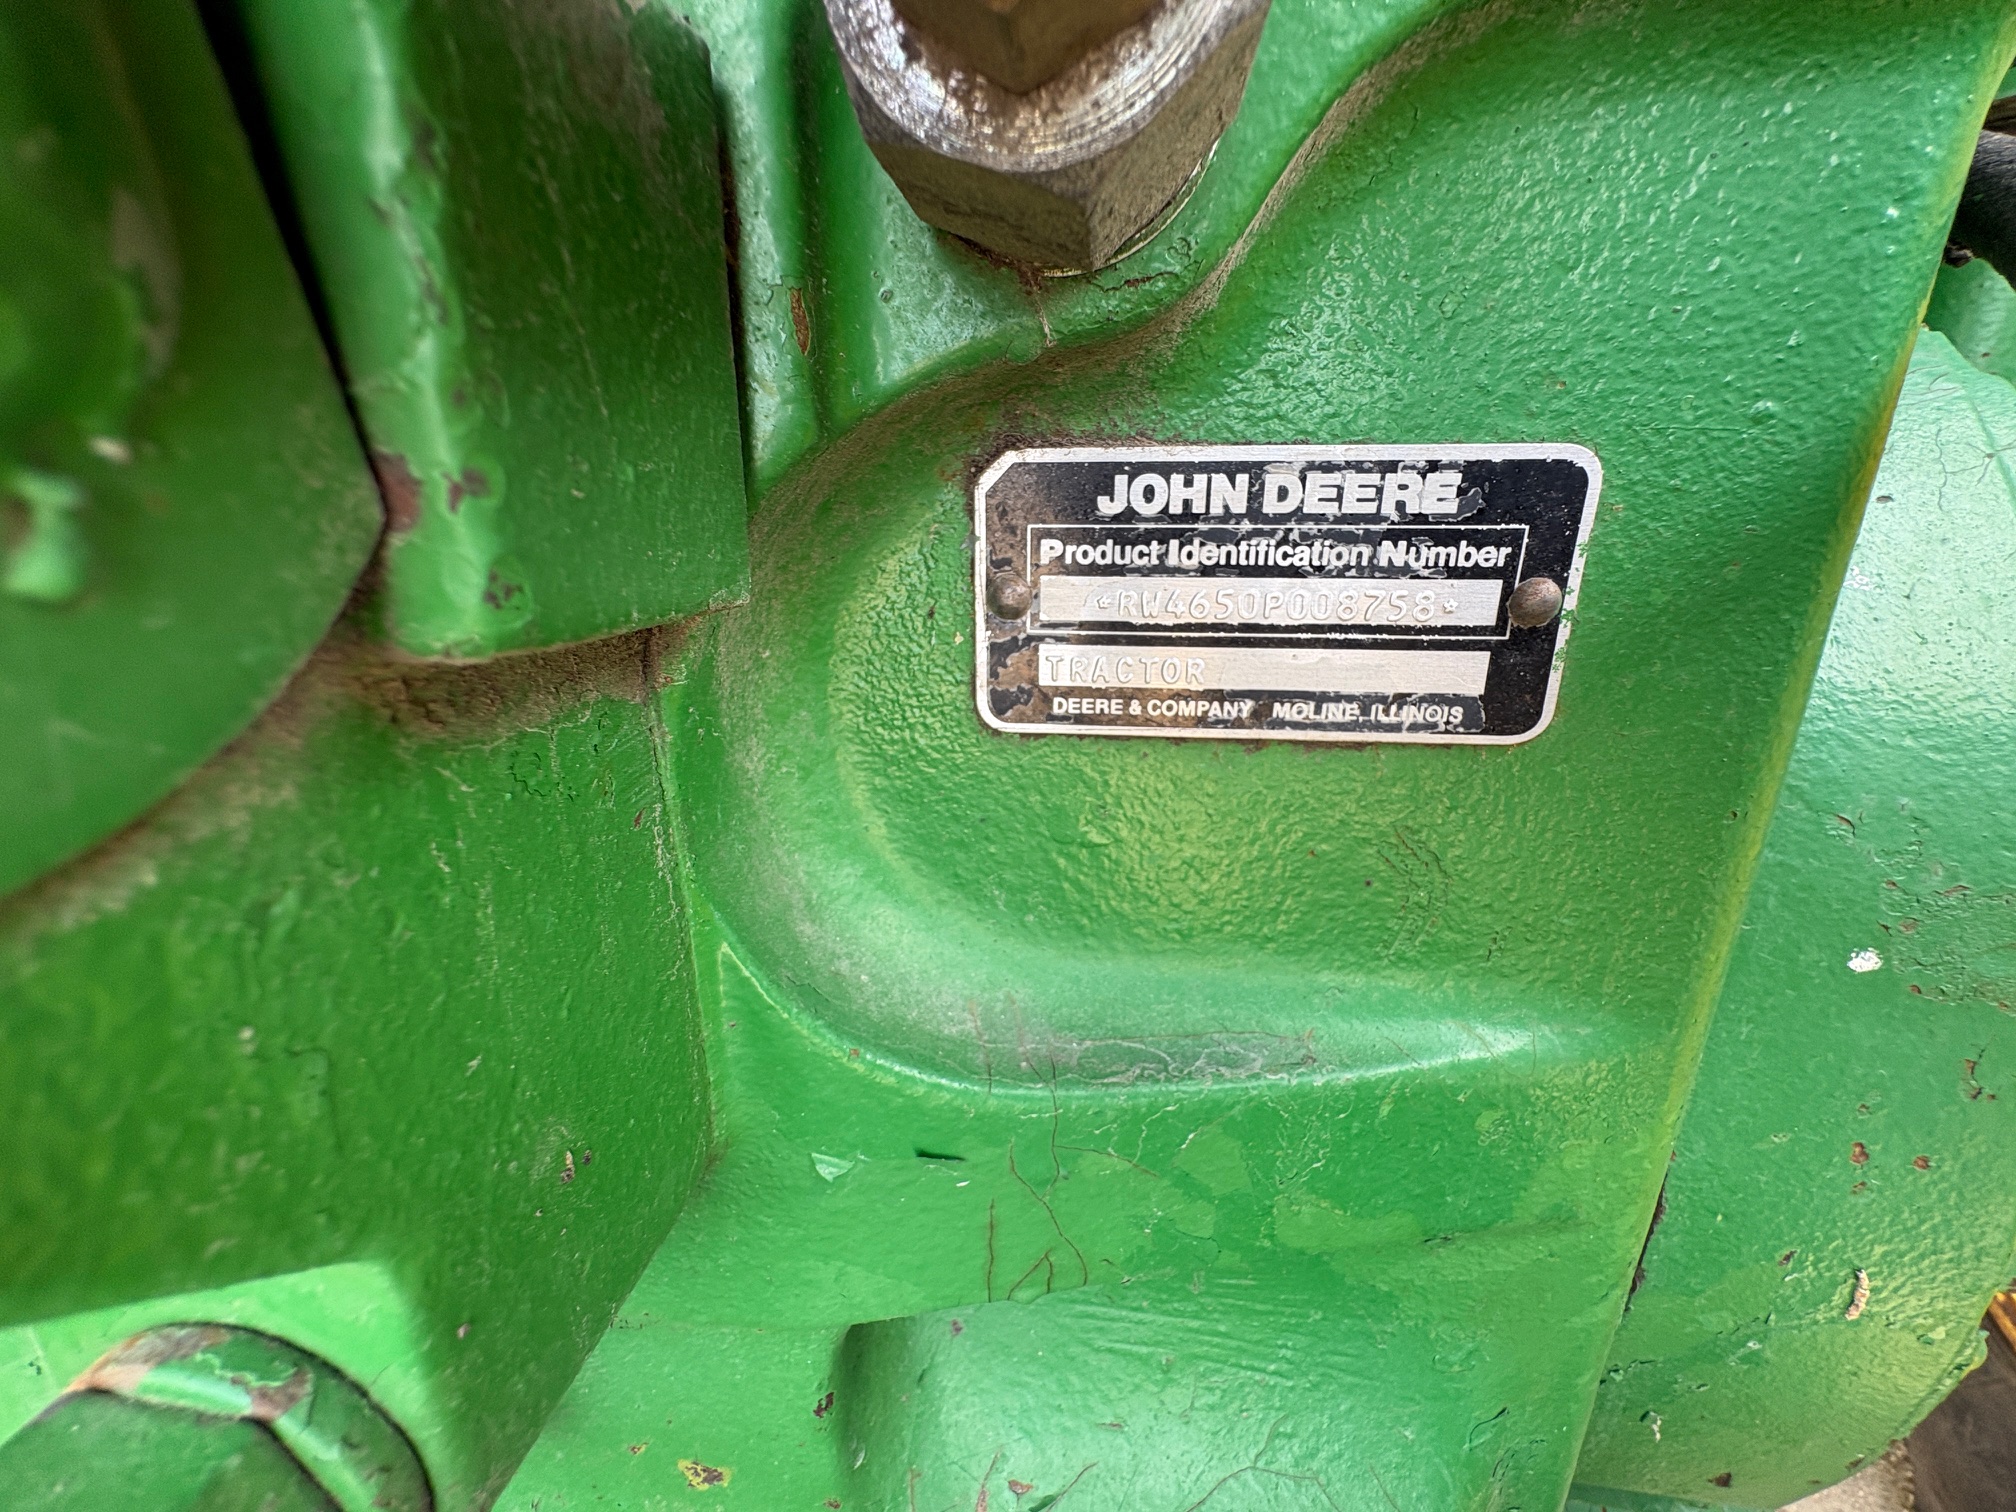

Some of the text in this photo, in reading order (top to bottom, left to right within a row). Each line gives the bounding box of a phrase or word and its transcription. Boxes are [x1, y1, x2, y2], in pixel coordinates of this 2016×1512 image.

[1097, 472, 1463, 515] JOHN DEERE
[1040, 538, 1513, 568] Product Identification Number
[1045, 655, 1206, 684] TRACTOR
[1052, 698, 1123, 716] DEERE
[1130, 699, 1142, 716] &
[1146, 699, 1254, 719] COMPANY
[1369, 705, 1464, 724] ILLINOIS
